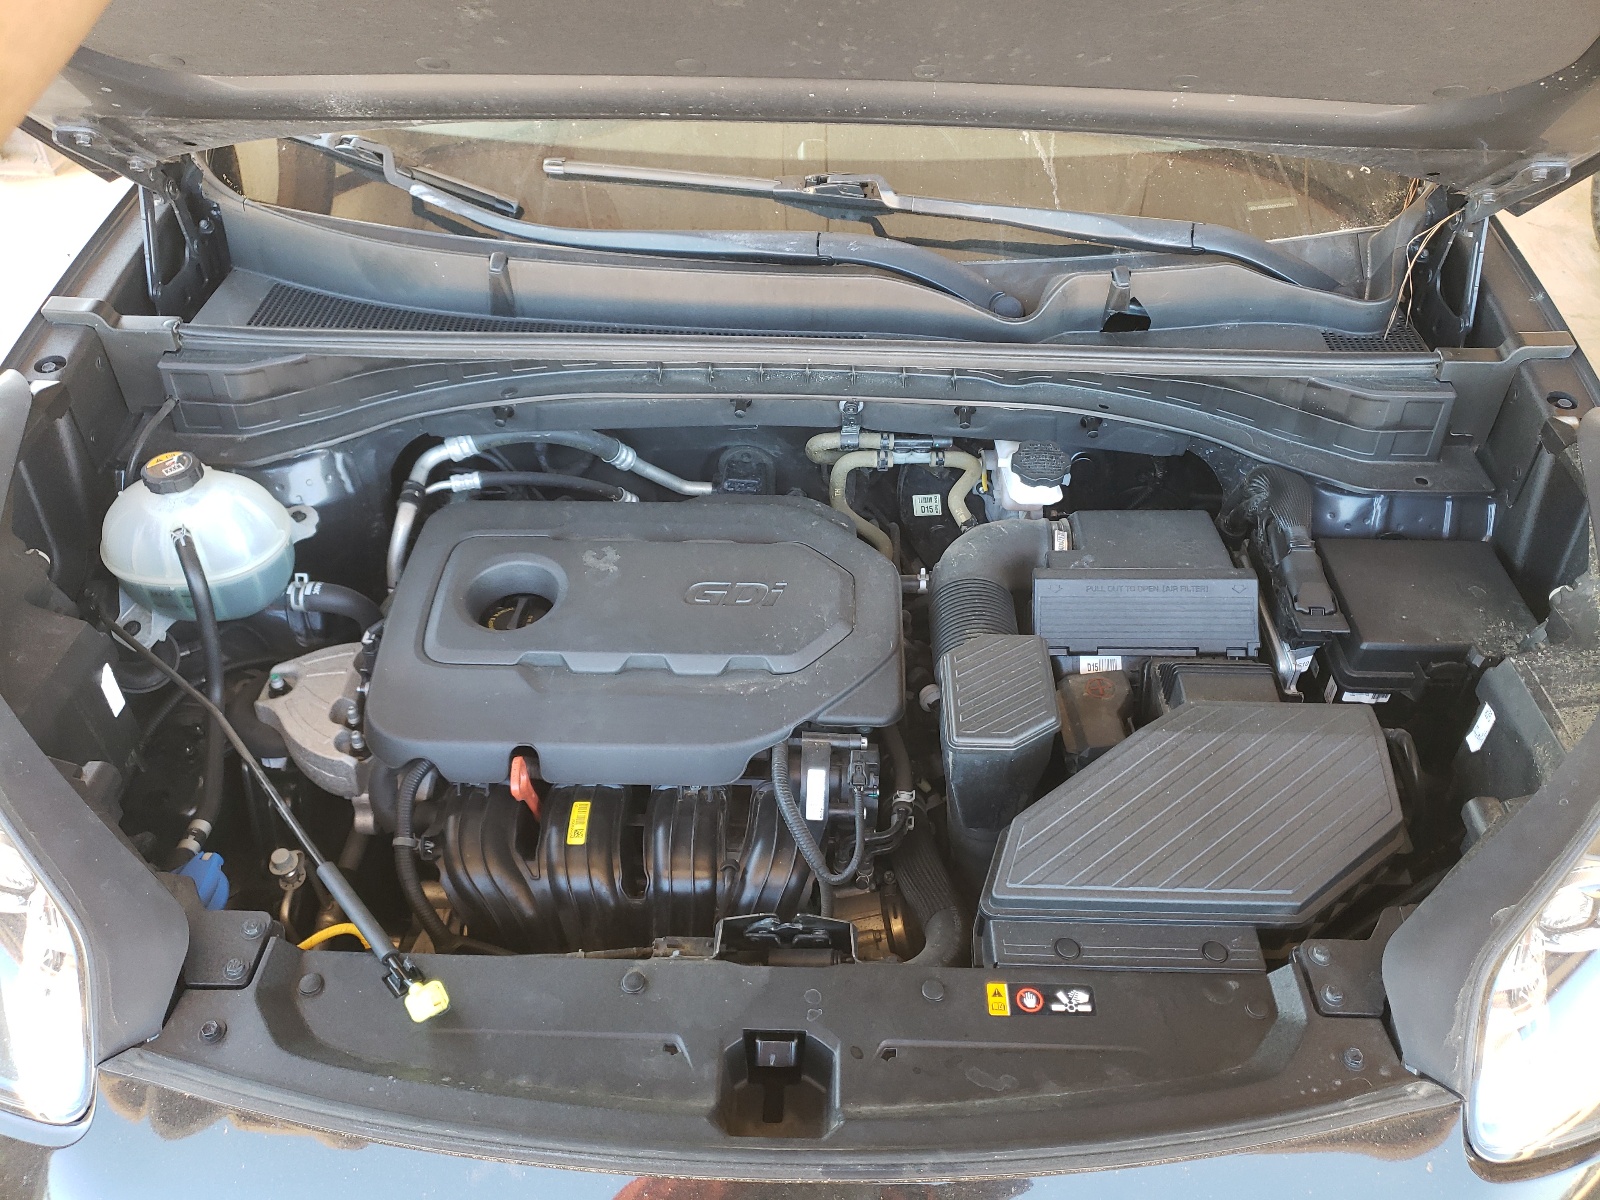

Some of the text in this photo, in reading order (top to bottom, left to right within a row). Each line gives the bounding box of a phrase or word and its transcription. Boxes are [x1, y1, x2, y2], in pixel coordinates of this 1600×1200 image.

[684, 581, 788, 606] GDi
[1085, 585, 1106, 593] PULL
[1107, 585, 1123, 593] OUT
[1125, 585, 1136, 593] TO
[1137, 585, 1159, 593] OPEN
